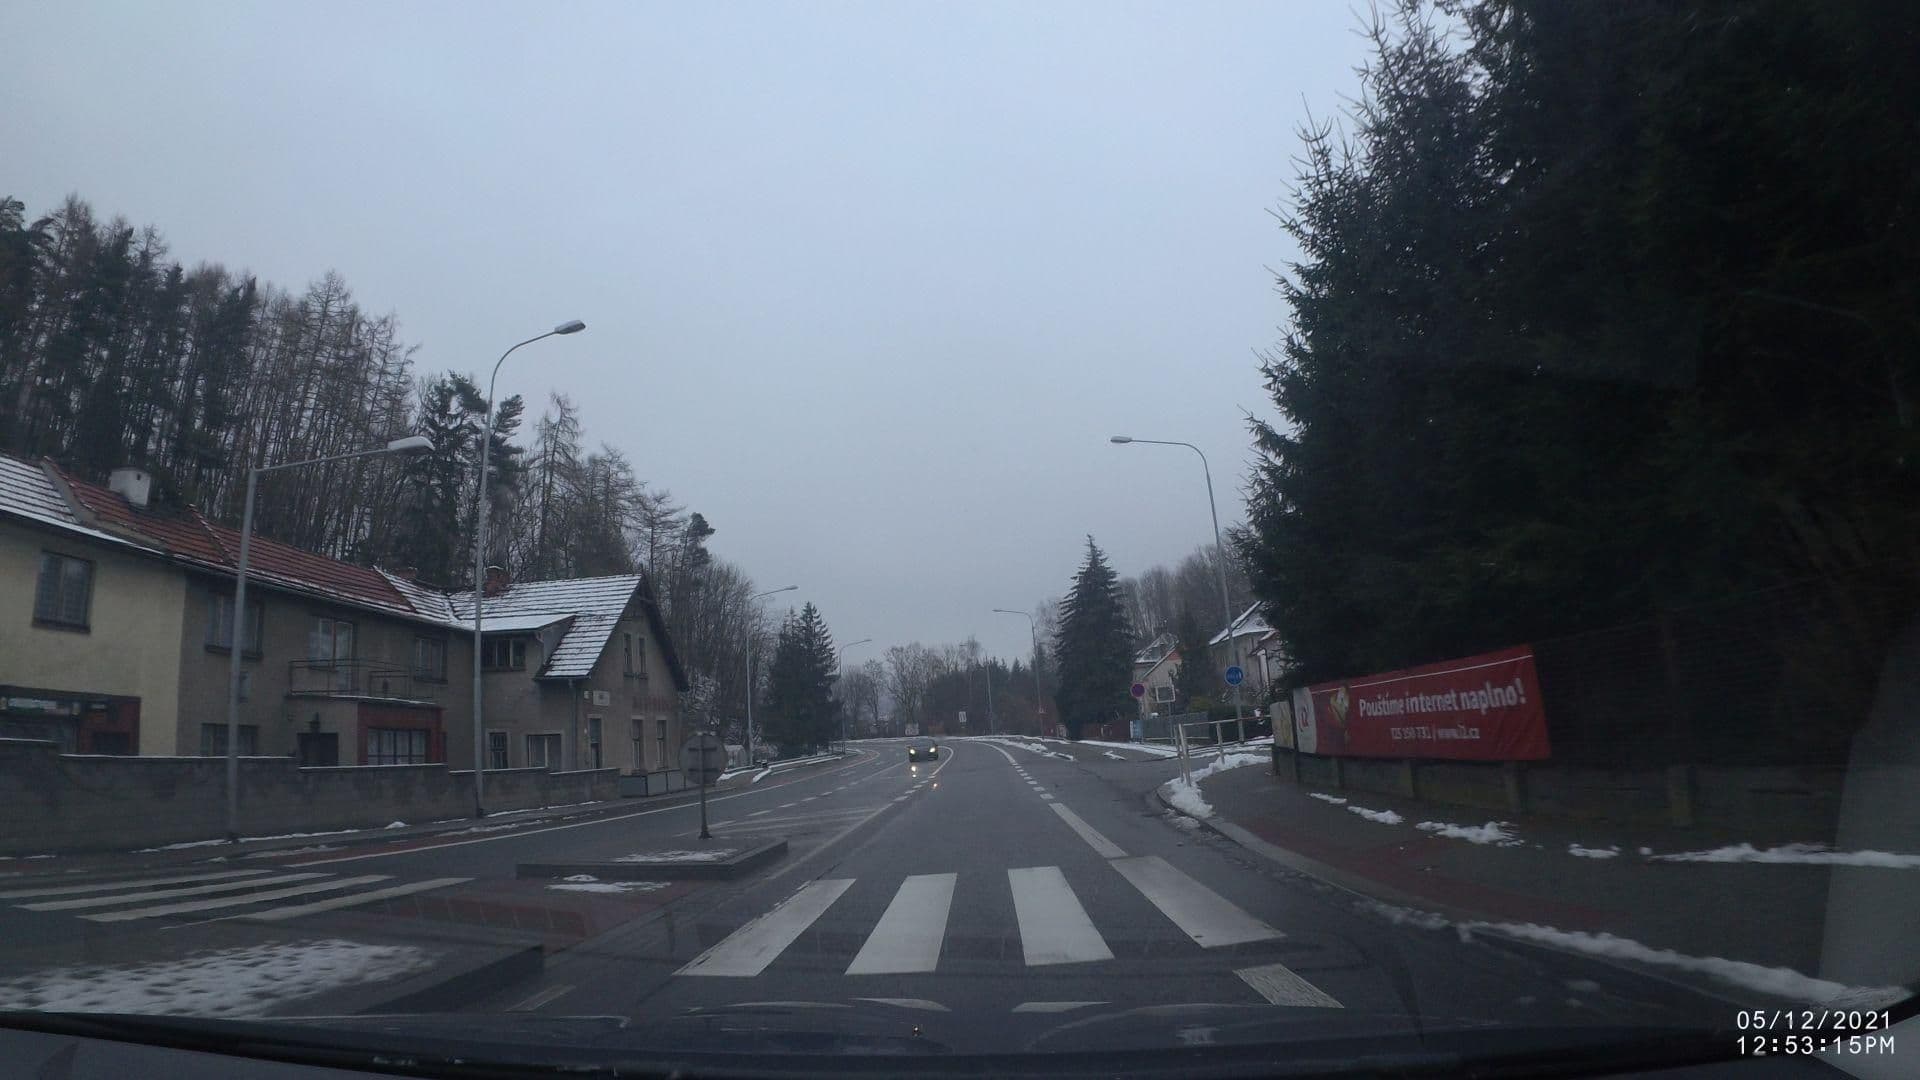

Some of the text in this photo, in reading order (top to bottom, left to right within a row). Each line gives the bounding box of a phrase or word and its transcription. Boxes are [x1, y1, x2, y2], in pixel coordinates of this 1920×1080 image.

[1359, 678, 1526, 717] Pouštíme internet naplno!
